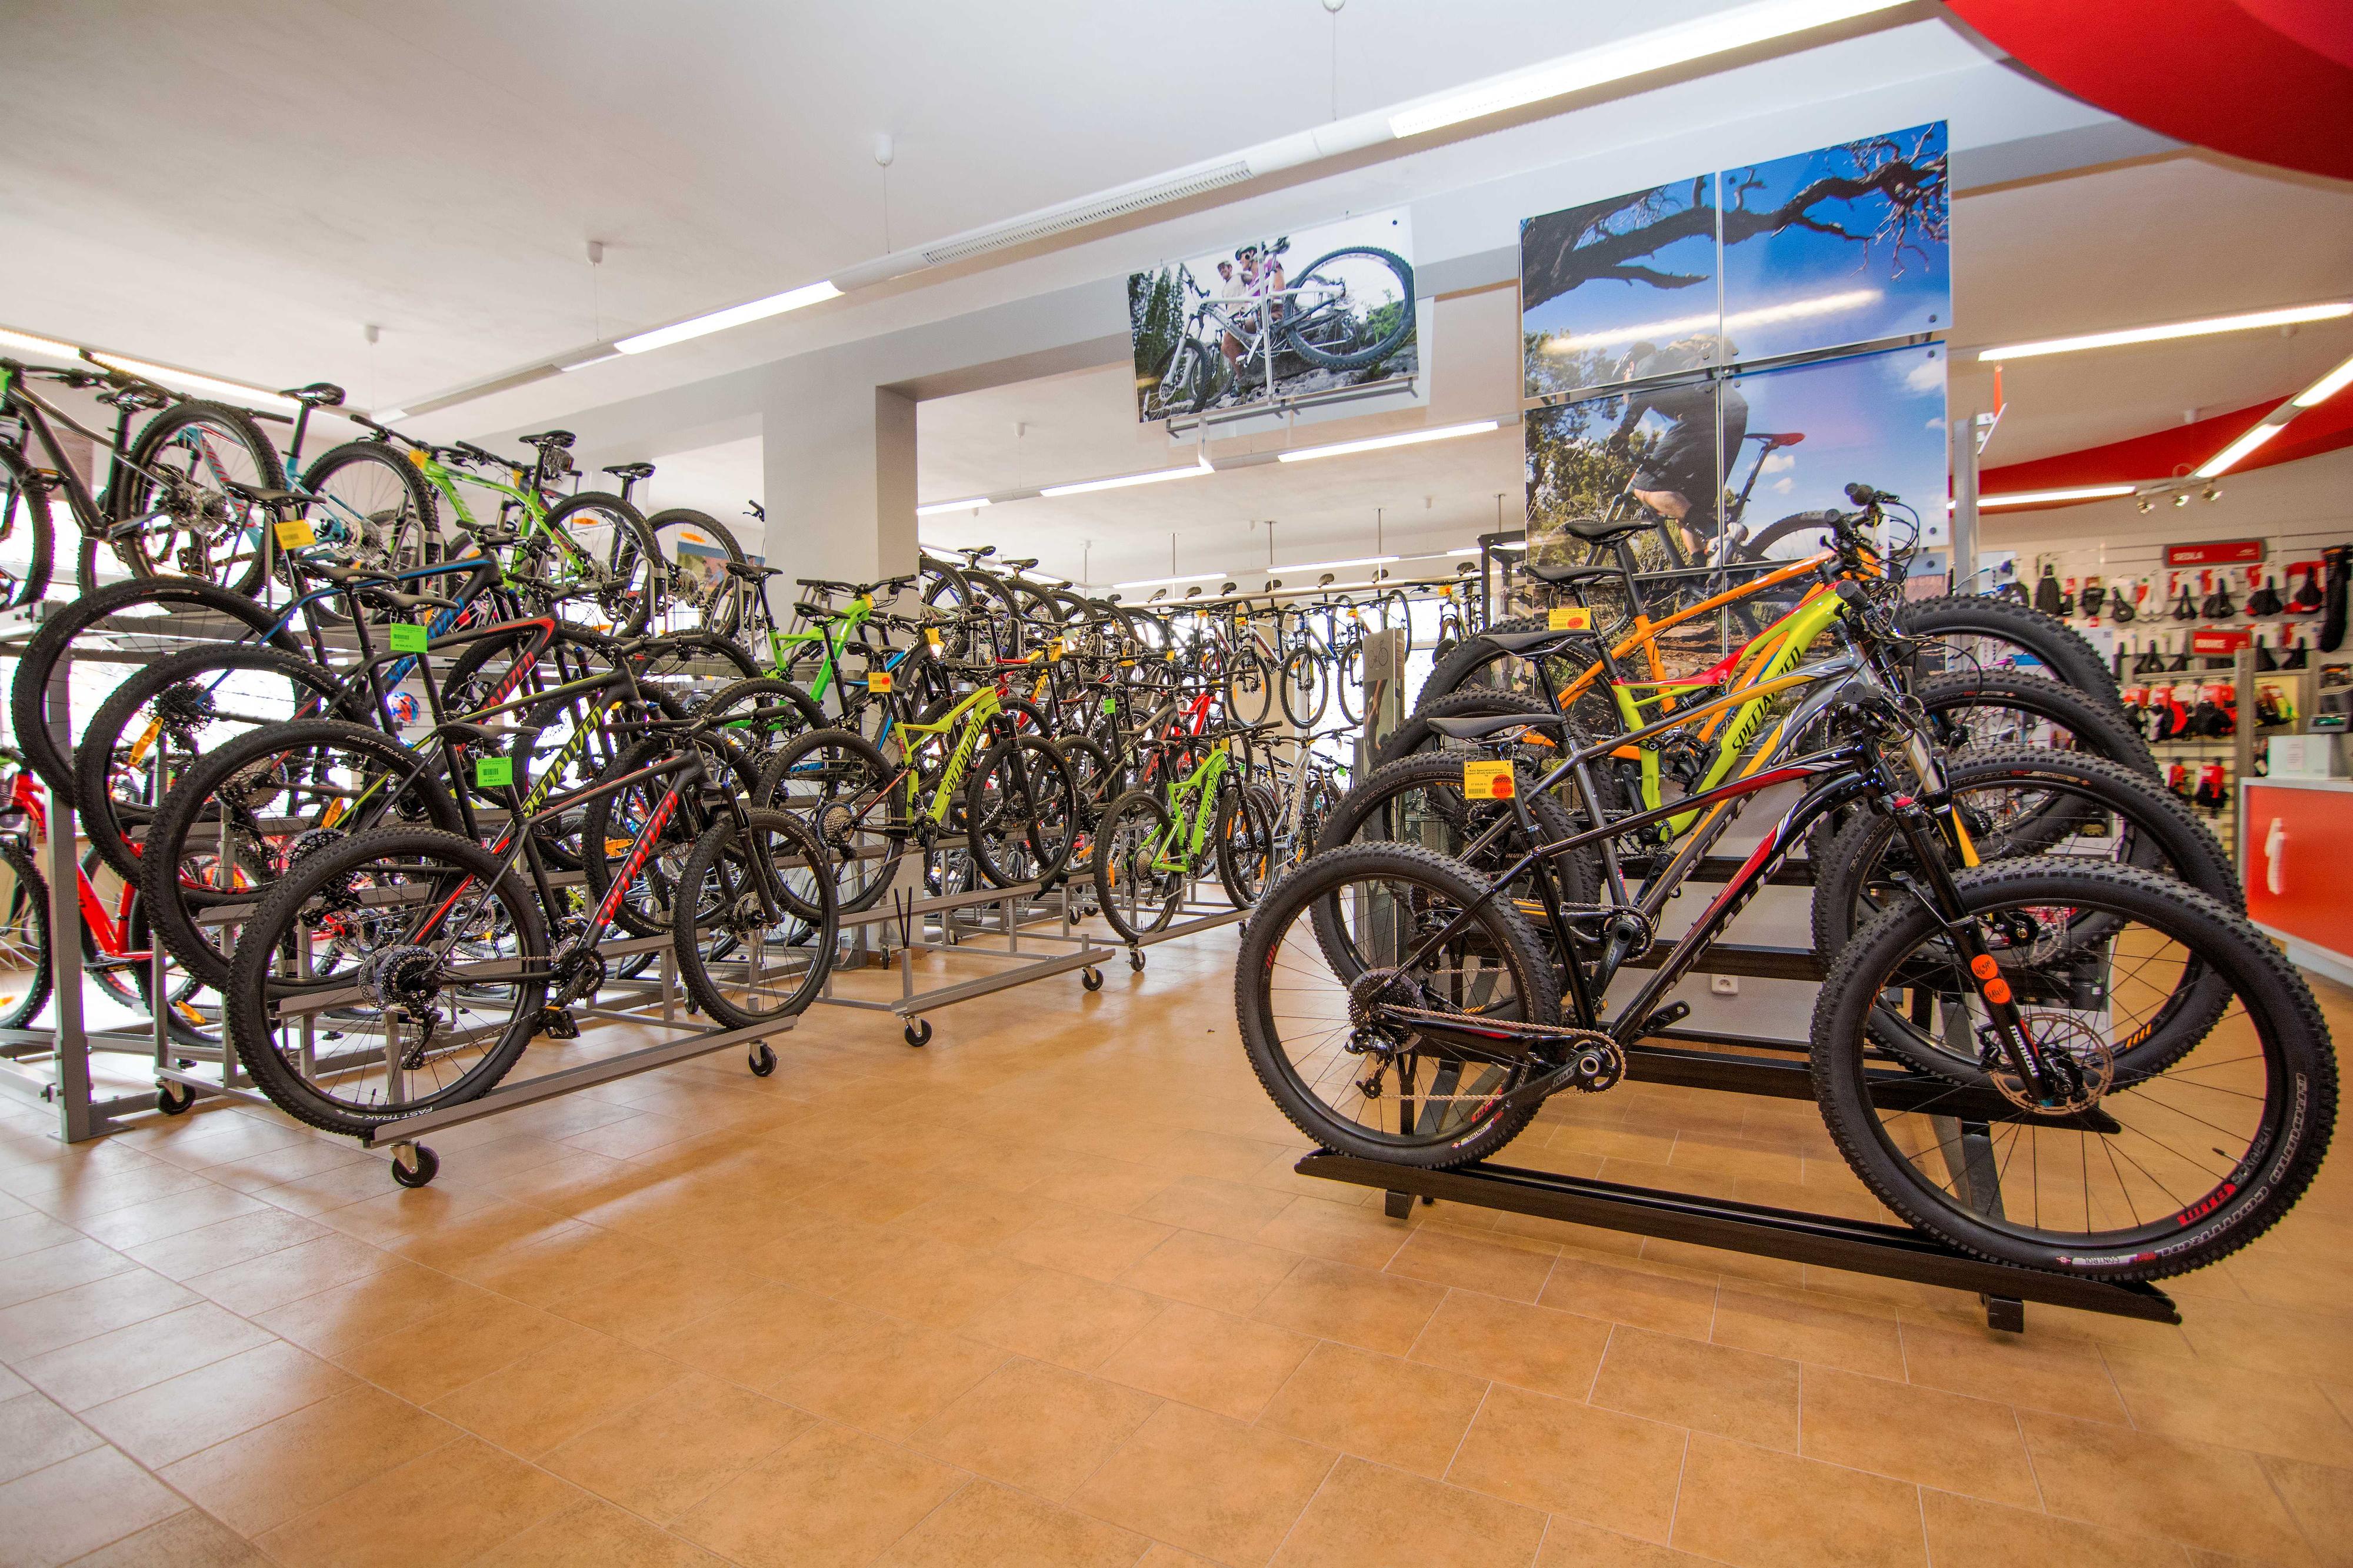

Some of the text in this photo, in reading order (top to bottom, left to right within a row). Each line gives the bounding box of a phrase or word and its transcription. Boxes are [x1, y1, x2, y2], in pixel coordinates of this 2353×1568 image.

[345, 735, 408, 762] FAST TRAK
[523, 706, 604, 818] PECIALIZED
[944, 718, 983, 797] SPECIALIZED
[596, 790, 678, 926] SPECIALIZED
[2009, 1025, 2041, 1077] manitou
[401, 1106, 433, 1119] FAST
[1467, 1126, 1487, 1141] CONTROL
[2085, 1256, 2120, 1265] CONTROL
